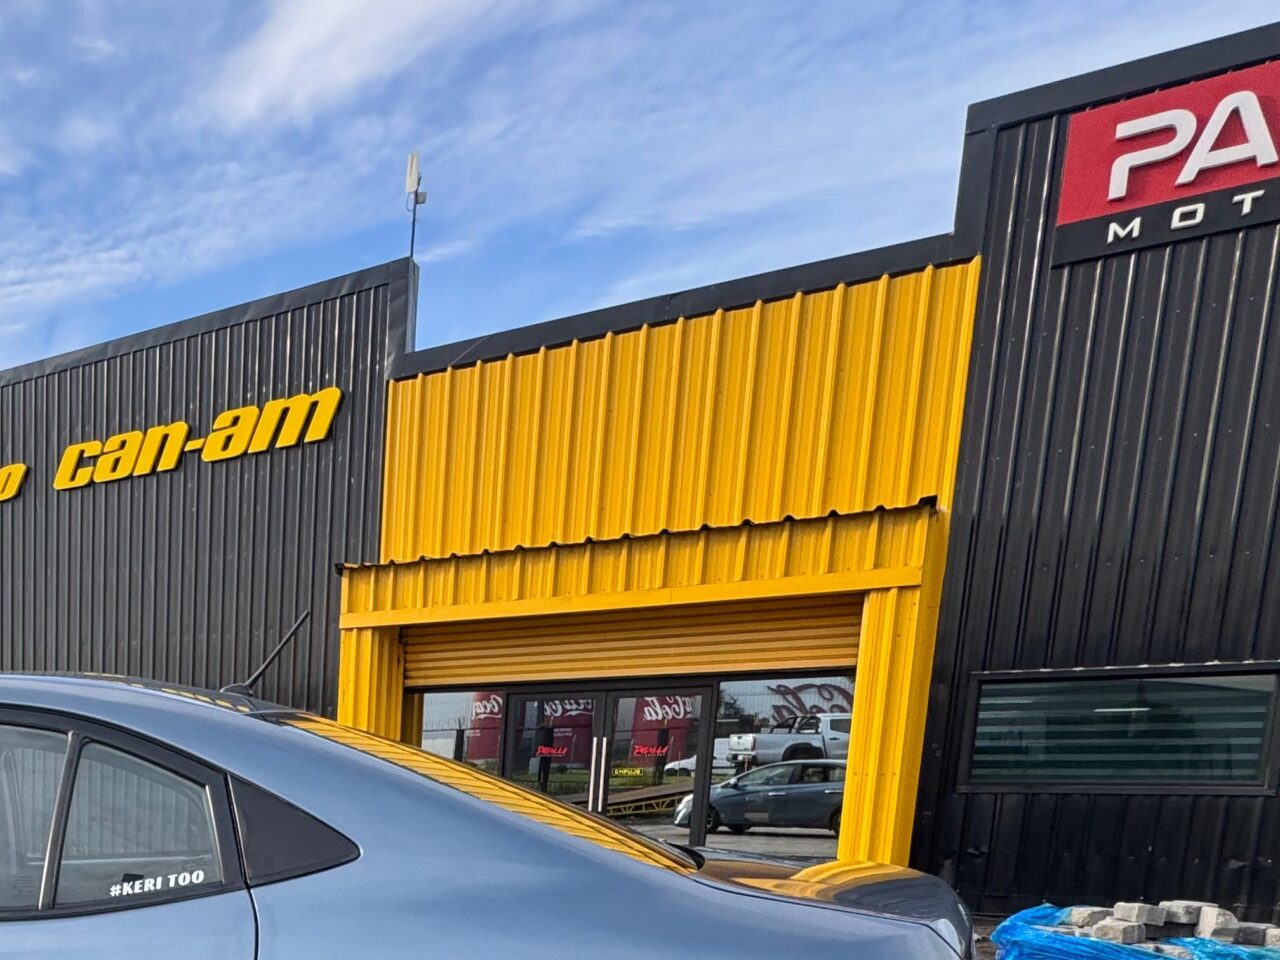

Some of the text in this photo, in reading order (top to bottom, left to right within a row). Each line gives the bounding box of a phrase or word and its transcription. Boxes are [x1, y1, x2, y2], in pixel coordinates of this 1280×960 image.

[53, 386, 342, 491] can-am
[109, 870, 205, 897] #KERI TOO
